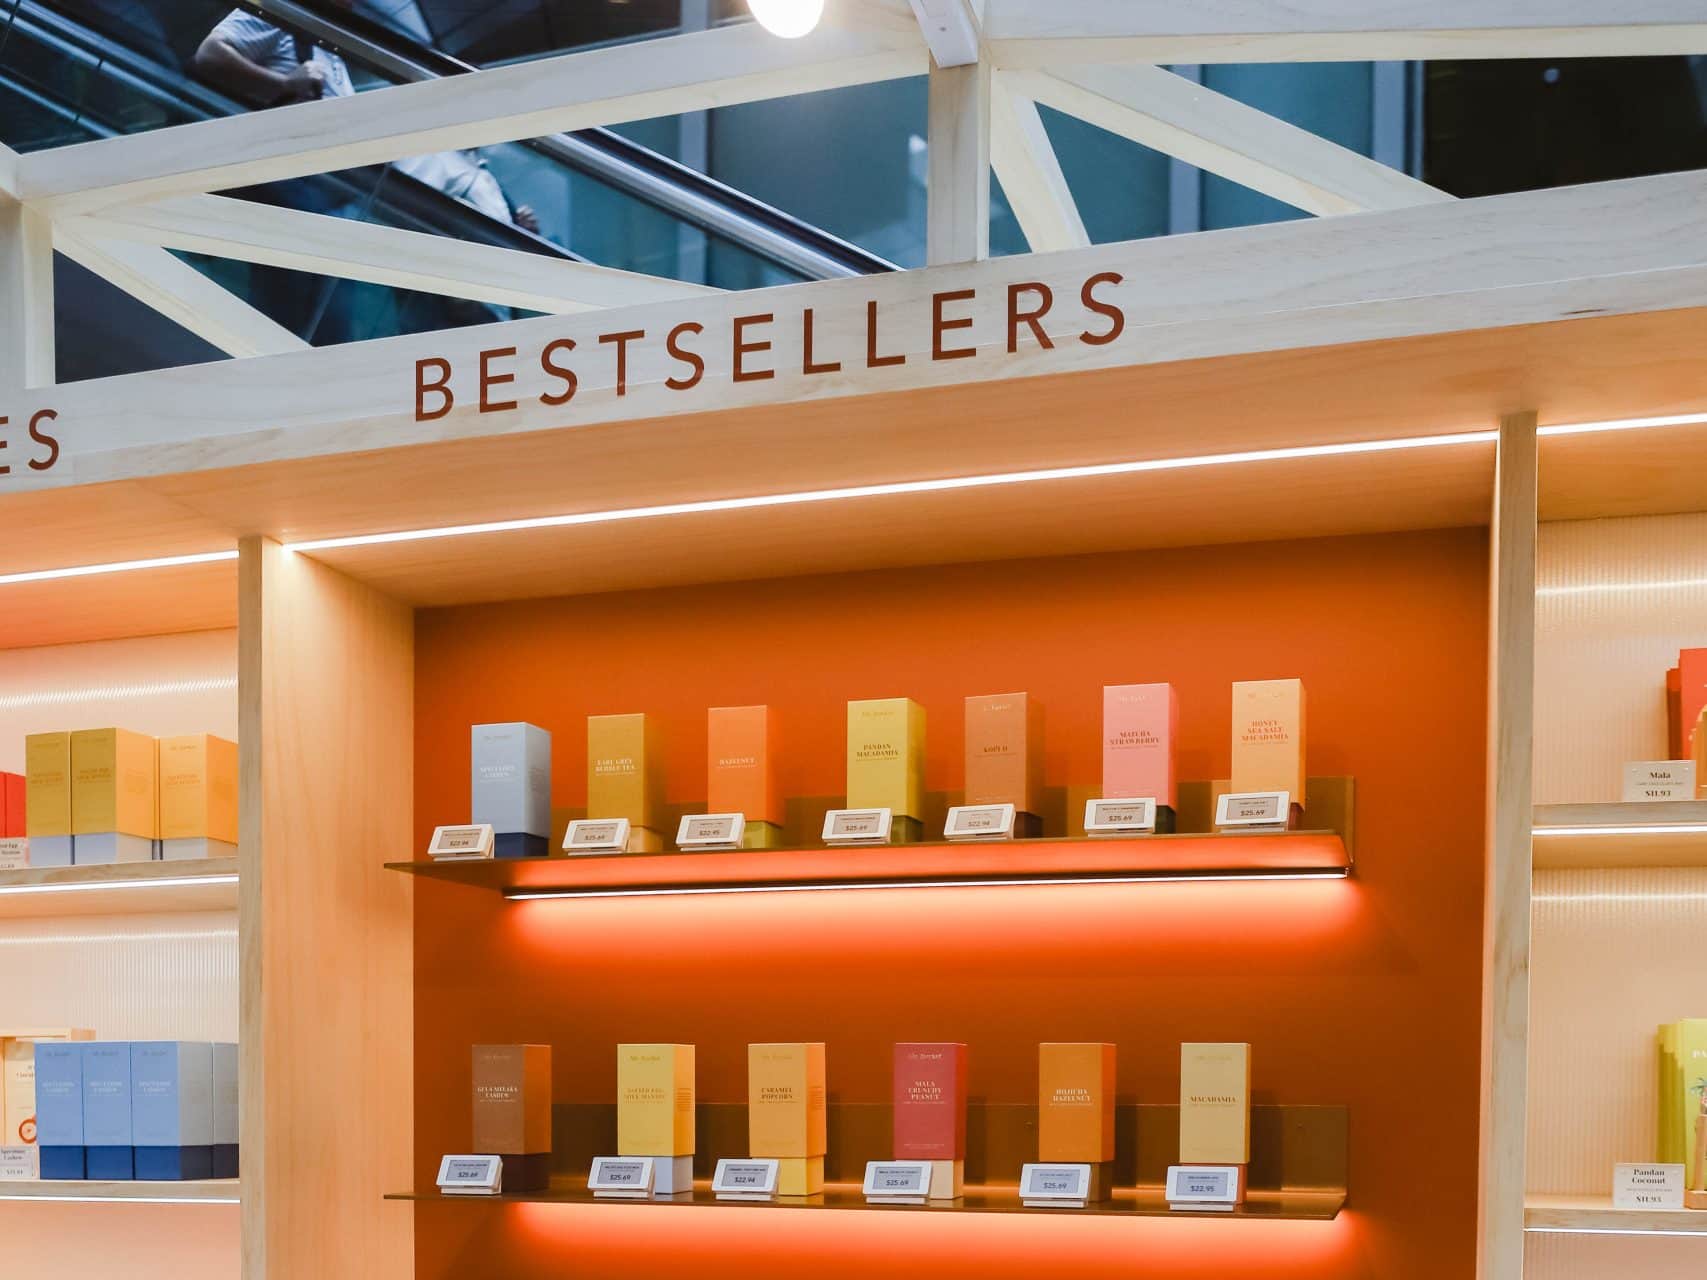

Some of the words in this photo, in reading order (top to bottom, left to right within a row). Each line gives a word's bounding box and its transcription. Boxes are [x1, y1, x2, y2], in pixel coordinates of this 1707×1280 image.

[415, 271, 1125, 422] BESTSELLERS
[1240, 809, 1265, 817] $25.69
[1634, 1168, 1665, 1176] Pandan
[1632, 1176, 1666, 1184] Coconut
